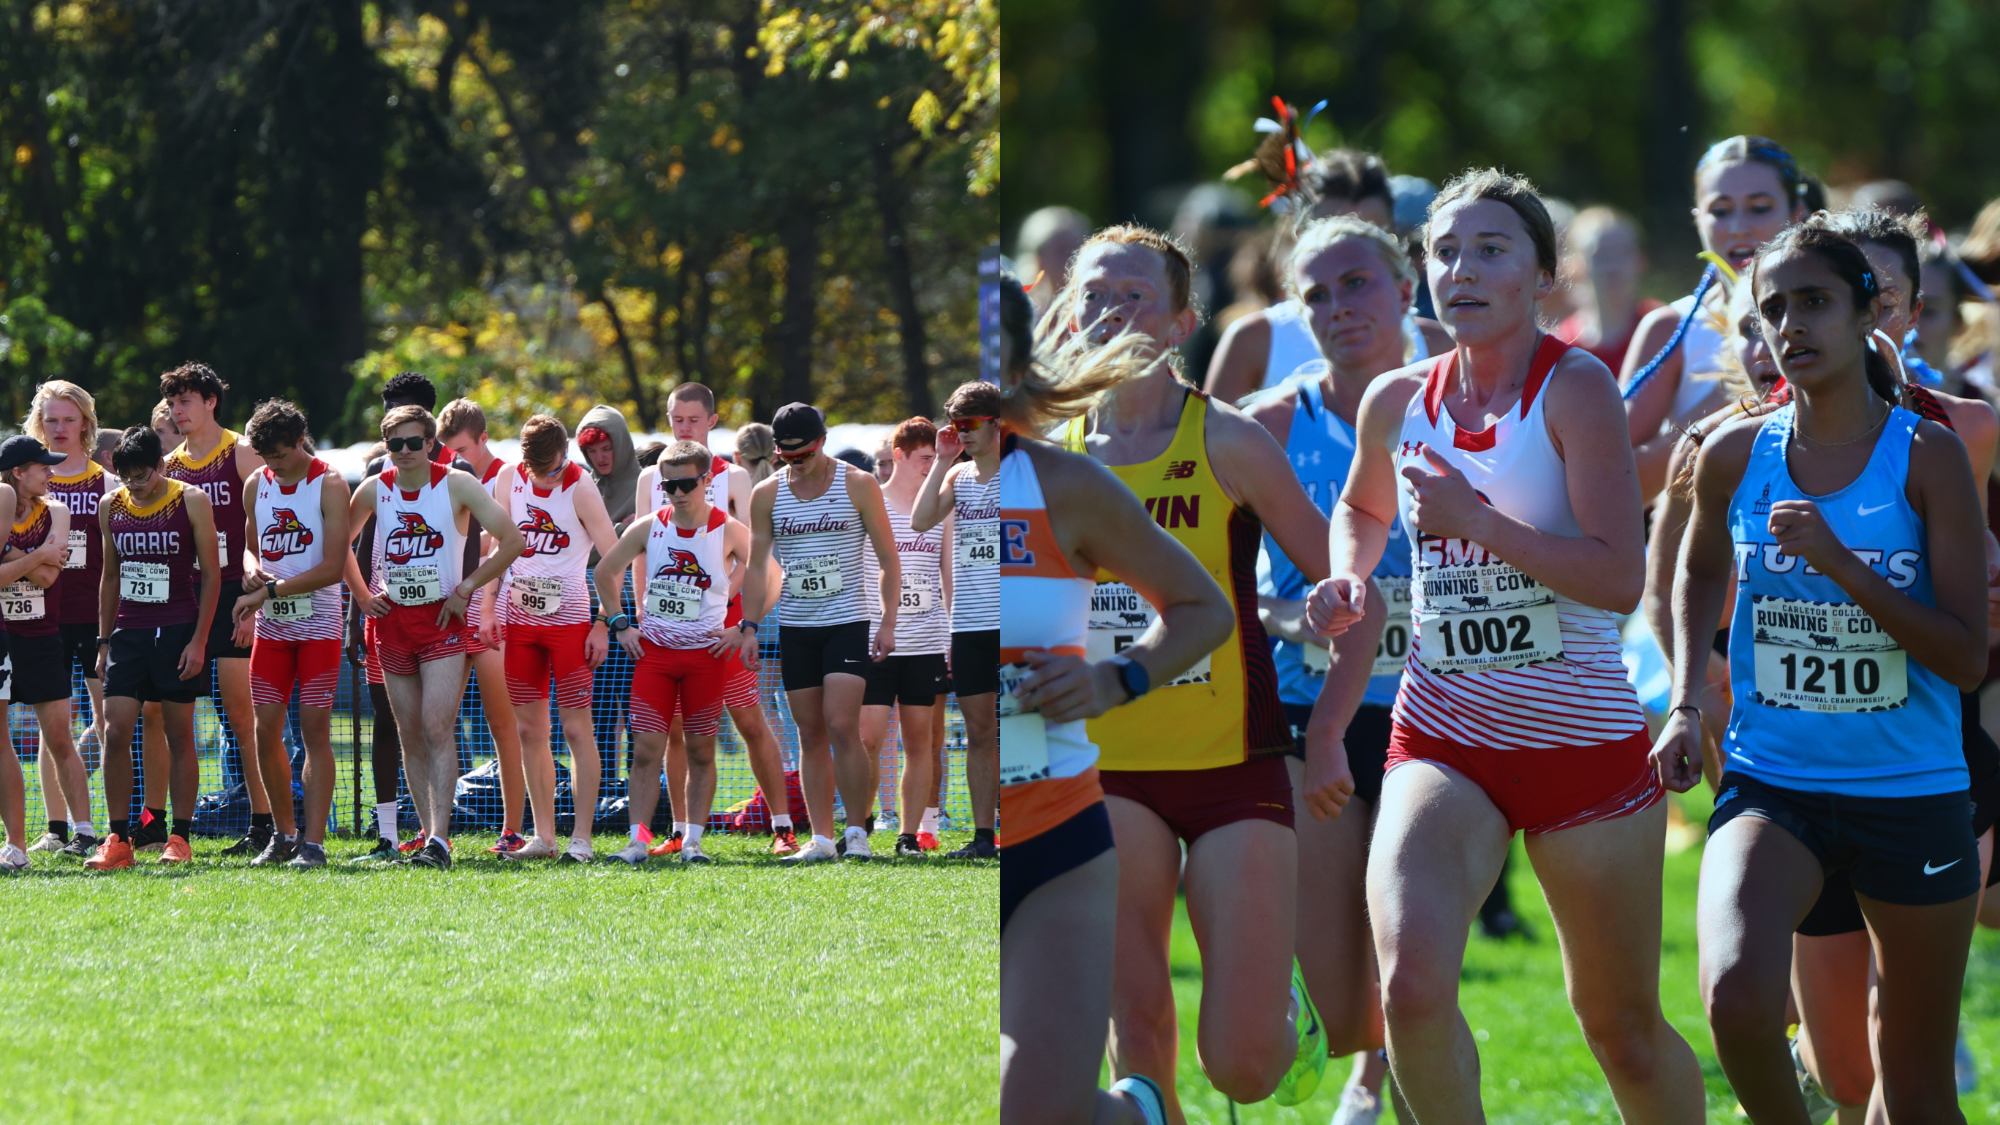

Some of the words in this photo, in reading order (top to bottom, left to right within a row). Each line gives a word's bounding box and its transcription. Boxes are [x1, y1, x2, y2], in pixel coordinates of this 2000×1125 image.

[956, 499, 1000, 520] Hamlin
[780, 512, 849, 536] Hamline
[112, 531, 180, 557] MORRIS
[969, 545, 995, 559] 448
[819, 558, 839, 568] COWS
[417, 568, 438, 577] COWS
[1437, 570, 1478, 579] CARLETON
[130, 581, 153, 596] 731
[399, 584, 426, 600] 990
[541, 582, 561, 591] COWS
[681, 586, 701, 596] COWS
[801, 576, 827, 592] 451
[1423, 578, 1479, 597] RUNNING
[1496, 573, 1545, 593] COW
[5, 600, 33, 614] 736
[272, 601, 297, 615] 991
[521, 593, 546, 610] 995
[659, 598, 685, 616] 993
[1091, 595, 1138, 612] NNING
[1782, 604, 1828, 617] CARLETON
[1757, 609, 1828, 633] RUNNING
[1438, 614, 1535, 657] 1002
[1442, 657, 1488, 666] PRE-NATIONAL
[1489, 650, 1541, 663] CHAMPIONSHIP
[1780, 652, 1881, 695] 1210
[1779, 692, 1829, 704] PRE-NATIONAL
[1830, 695, 1885, 704] CHAMPIONSHIP
